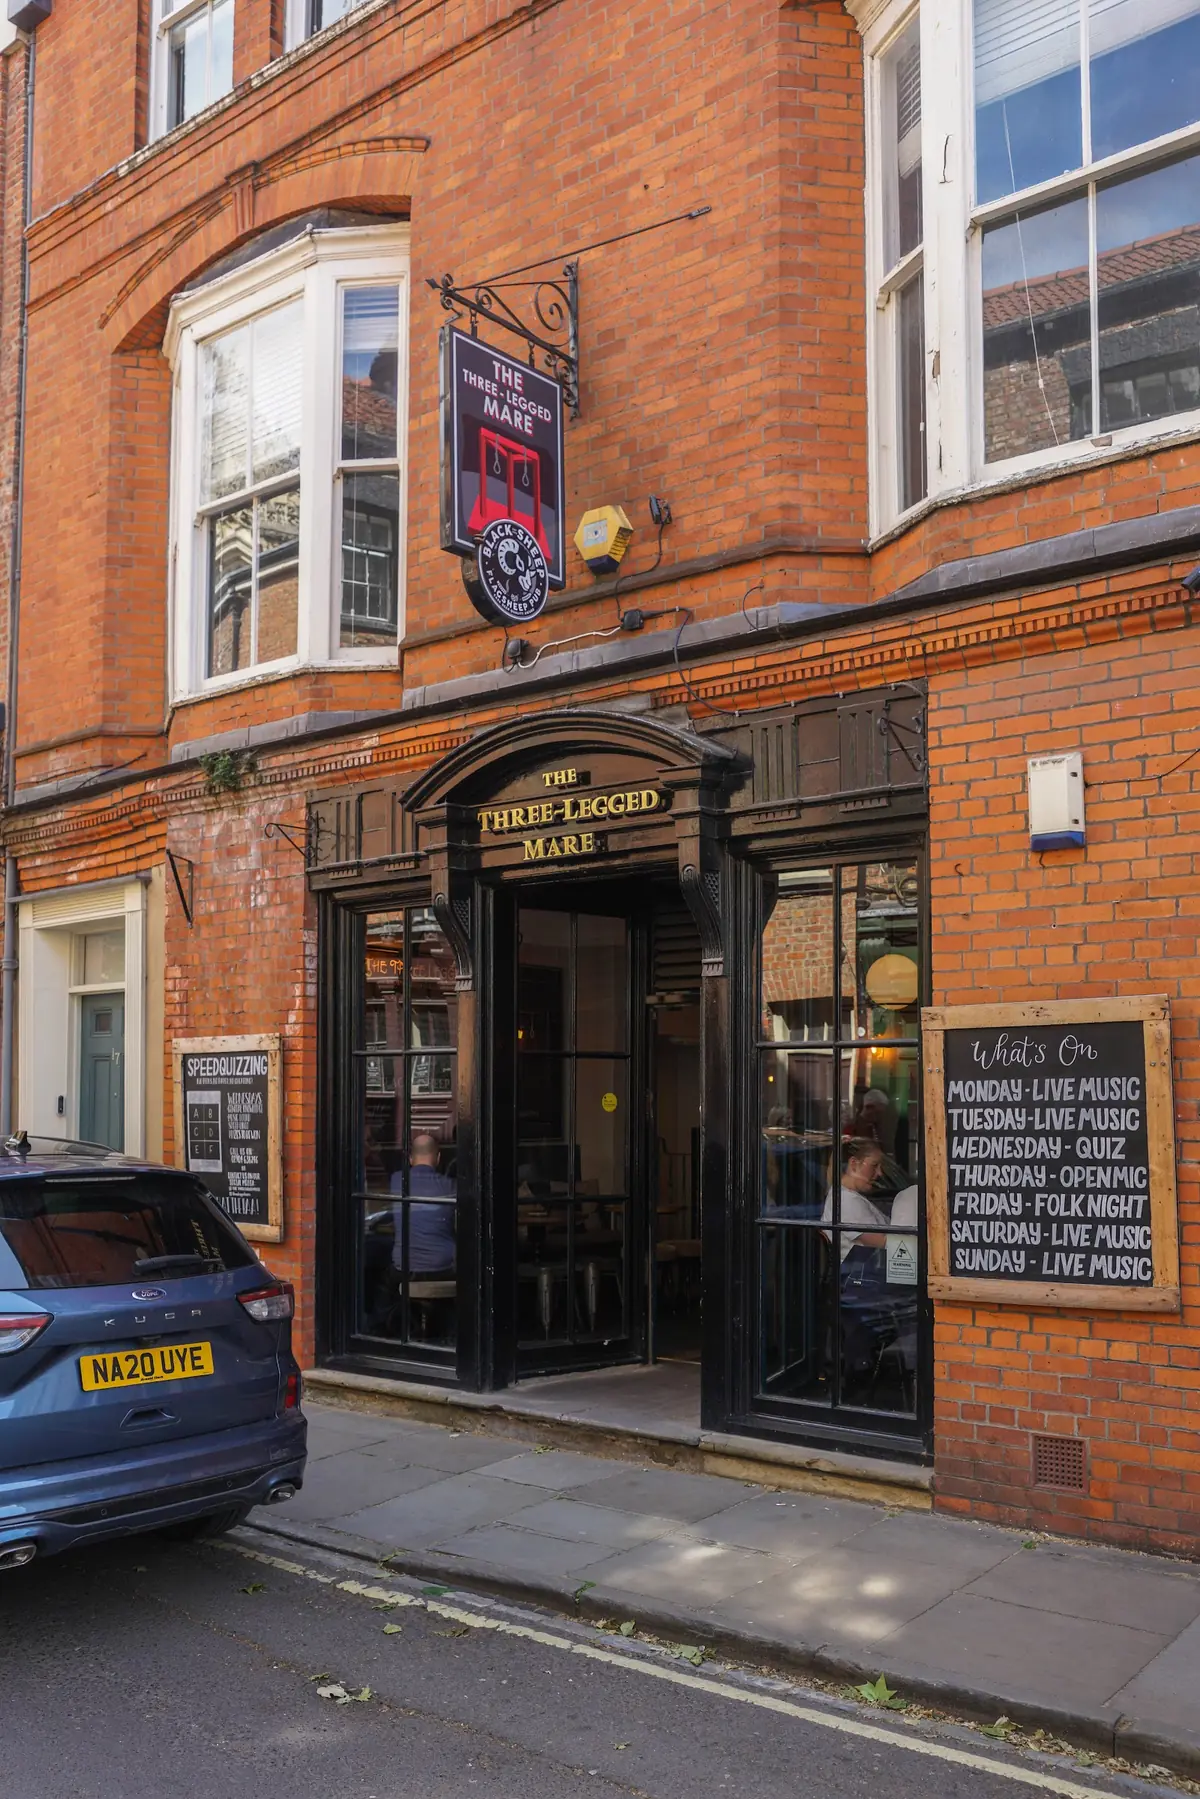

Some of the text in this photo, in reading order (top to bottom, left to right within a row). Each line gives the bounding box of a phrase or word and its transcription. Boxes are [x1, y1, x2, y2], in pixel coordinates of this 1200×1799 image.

[493, 360, 523, 392] THE
[462, 368, 498, 396] THREE
[506, 390, 552, 422] LEGGED
[484, 396, 534, 434] MARE
[483, 524, 544, 578] BLACK SHEEP
[486, 570, 528, 612] FLAGSHEEP
[529, 588, 542, 607] PUB
[542, 768, 577, 787] THE
[478, 790, 660, 832] THREE-LEGGED
[523, 833, 594, 861] MARE
[970, 1032, 1098, 1070] What's On
[188, 1056, 268, 1076] SPEEDQUIZZING
[948, 1078, 1022, 1102] MONDAY
[1032, 1078, 1076, 1101] LIVE
[1078, 1077, 1140, 1101] MUSIC
[194, 1108, 212, 1118] A B
[948, 1108, 1026, 1131] TUESDAY
[1034, 1108, 1076, 1131] LIVE
[1078, 1108, 1140, 1131] MUSIC
[194, 1127, 213, 1137] C D
[195, 1145, 214, 1154] E F
[952, 1136, 1062, 1159] WEDNESDAY
[1076, 1137, 1126, 1160] QUIZ
[950, 1165, 1046, 1187] THURSDAY
[954, 1192, 1022, 1216] FRIDAY
[1034, 1194, 1084, 1217] FOLK
[1087, 1195, 1148, 1218] NIGHT
[952, 1220, 1041, 1245] SATURDAY
[1052, 1224, 1092, 1247] LIVE
[1094, 1225, 1151, 1250] MUSIC
[956, 1248, 1026, 1273] SUNDAY
[1042, 1252, 1086, 1276] LIVE
[1088, 1255, 1152, 1280] MUSIC
[141, 1289, 158, 1298] Ford
[104, 1309, 201, 1326] KUGA
[92, 1346, 204, 1384] NA20 UYE
